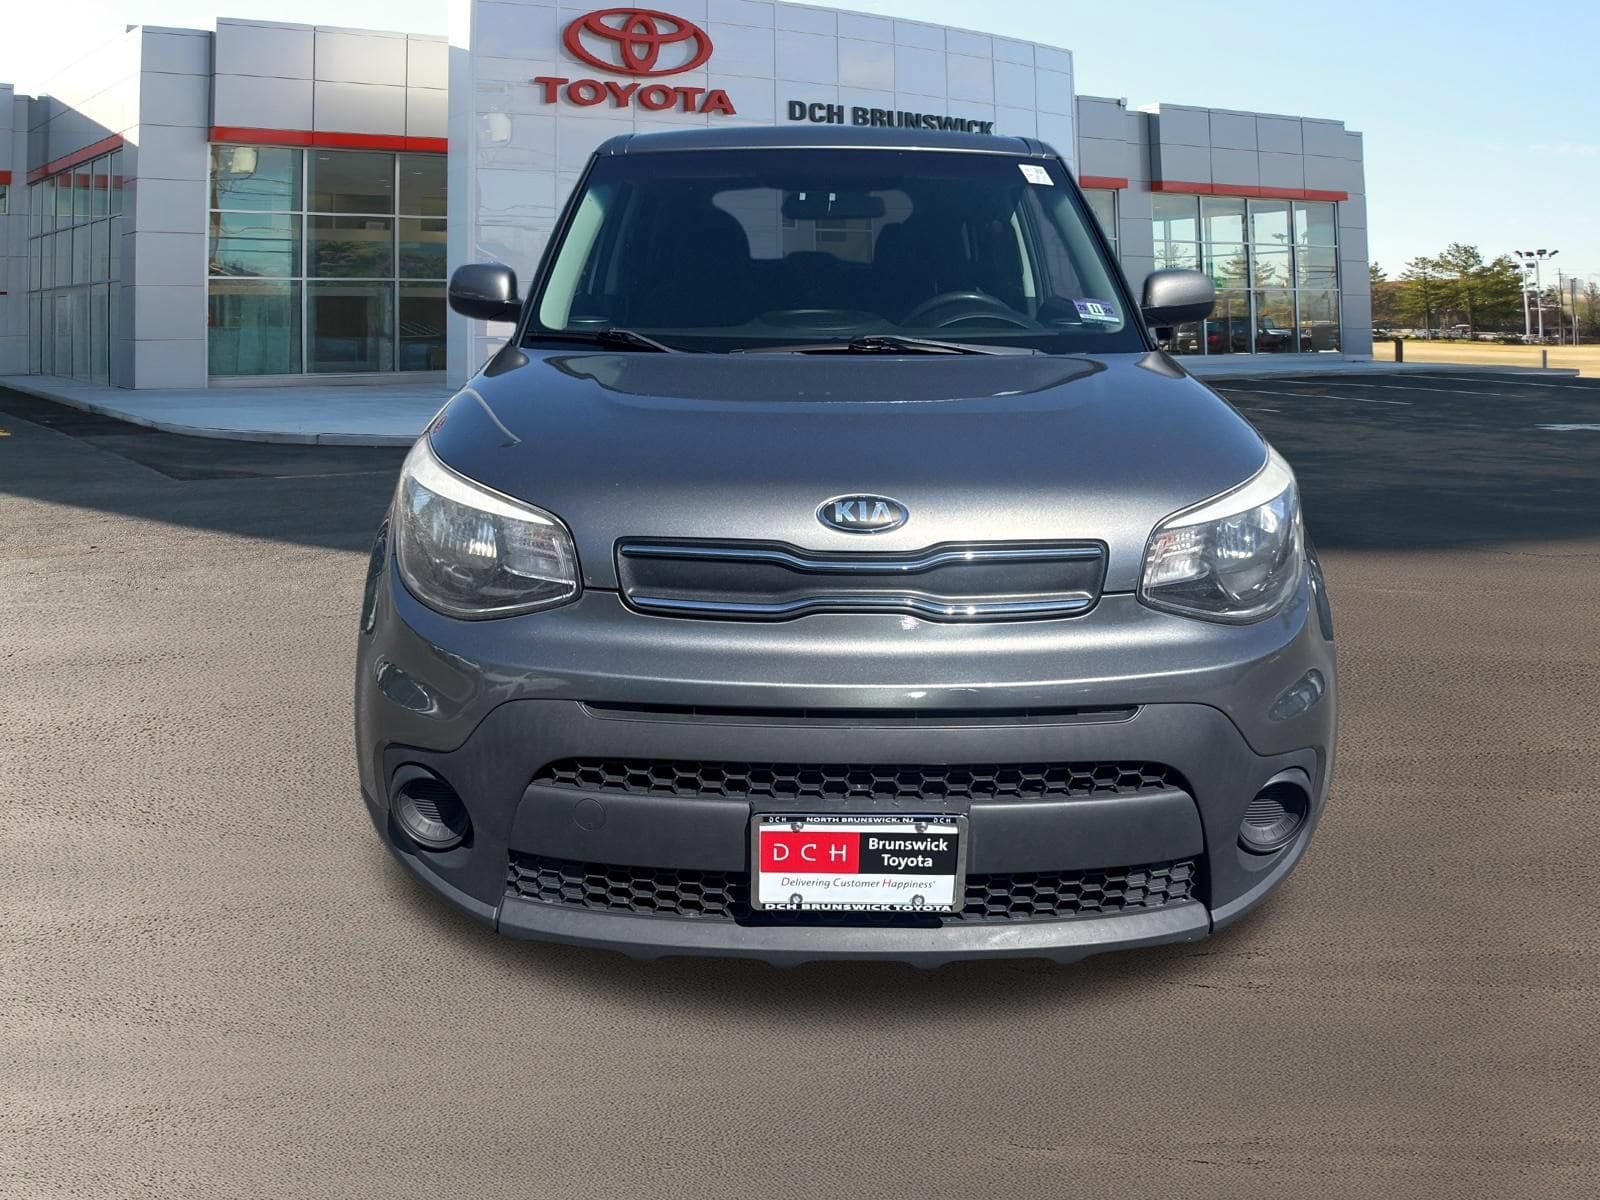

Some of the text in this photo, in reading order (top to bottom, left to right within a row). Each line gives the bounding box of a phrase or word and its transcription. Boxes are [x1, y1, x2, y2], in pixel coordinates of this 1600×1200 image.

[534, 76, 736, 115] TOYOTA
[788, 100, 994, 136] DCH BRUNSWICK
[834, 500, 893, 523] KIA
[868, 838, 948, 851] Brunswick
[881, 854, 933, 870] Toyota
[781, 877, 831, 889] Delivering
[833, 878, 880, 888] Customer
[801, 903, 890, 911] BRUNSWICK
[893, 904, 952, 912] TOYOTA
